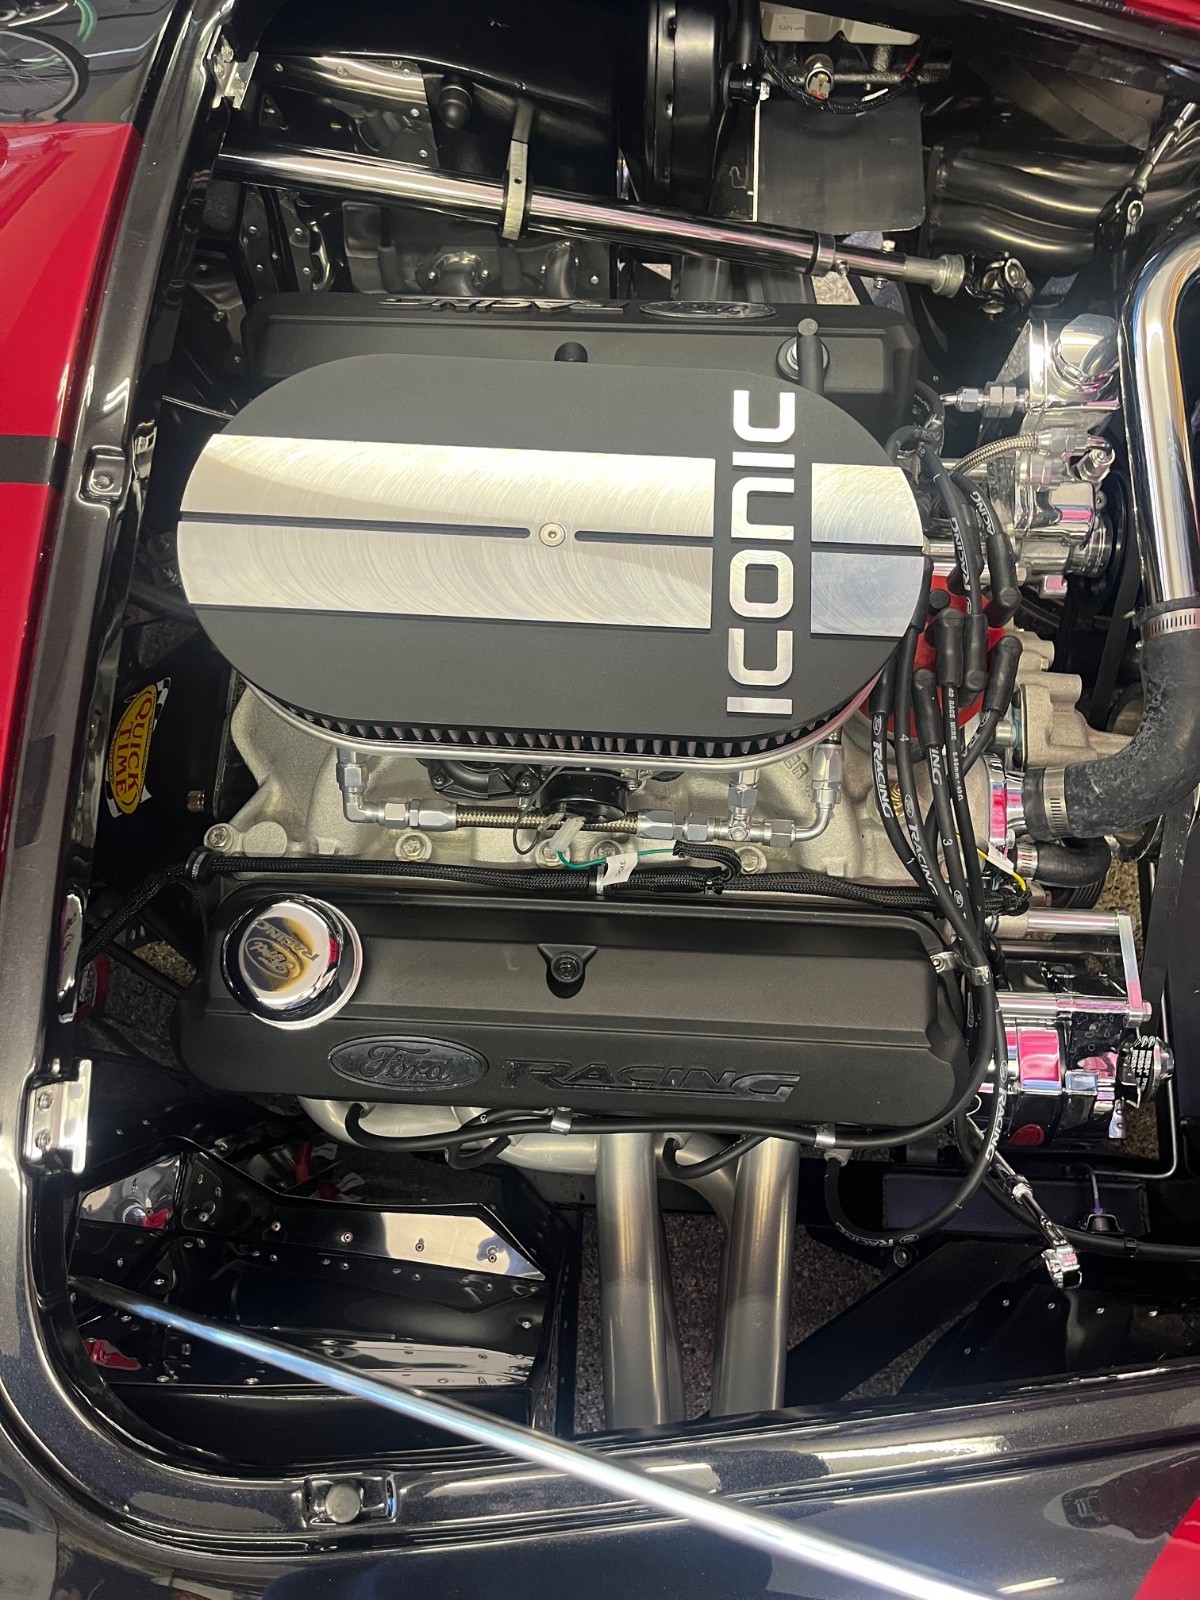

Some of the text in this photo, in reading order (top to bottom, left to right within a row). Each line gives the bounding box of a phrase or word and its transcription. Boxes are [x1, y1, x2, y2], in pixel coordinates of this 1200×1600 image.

[970, 491, 996, 536] ACING
[727, 389, 796, 715] ICONIC
[950, 517, 971, 591] RACING
[115, 722, 132, 797] TIME
[127, 697, 153, 791] QUICK
[900, 733, 910, 743] 4
[950, 721, 958, 741] WIRE
[872, 741, 895, 818] RACING
[908, 824, 939, 896] RACING
[942, 838, 953, 847] 3
[359, 1044, 801, 1103] Ford RACING
[985, 1087, 1007, 1162] RACING
[835, 1221, 894, 1247] RACING
